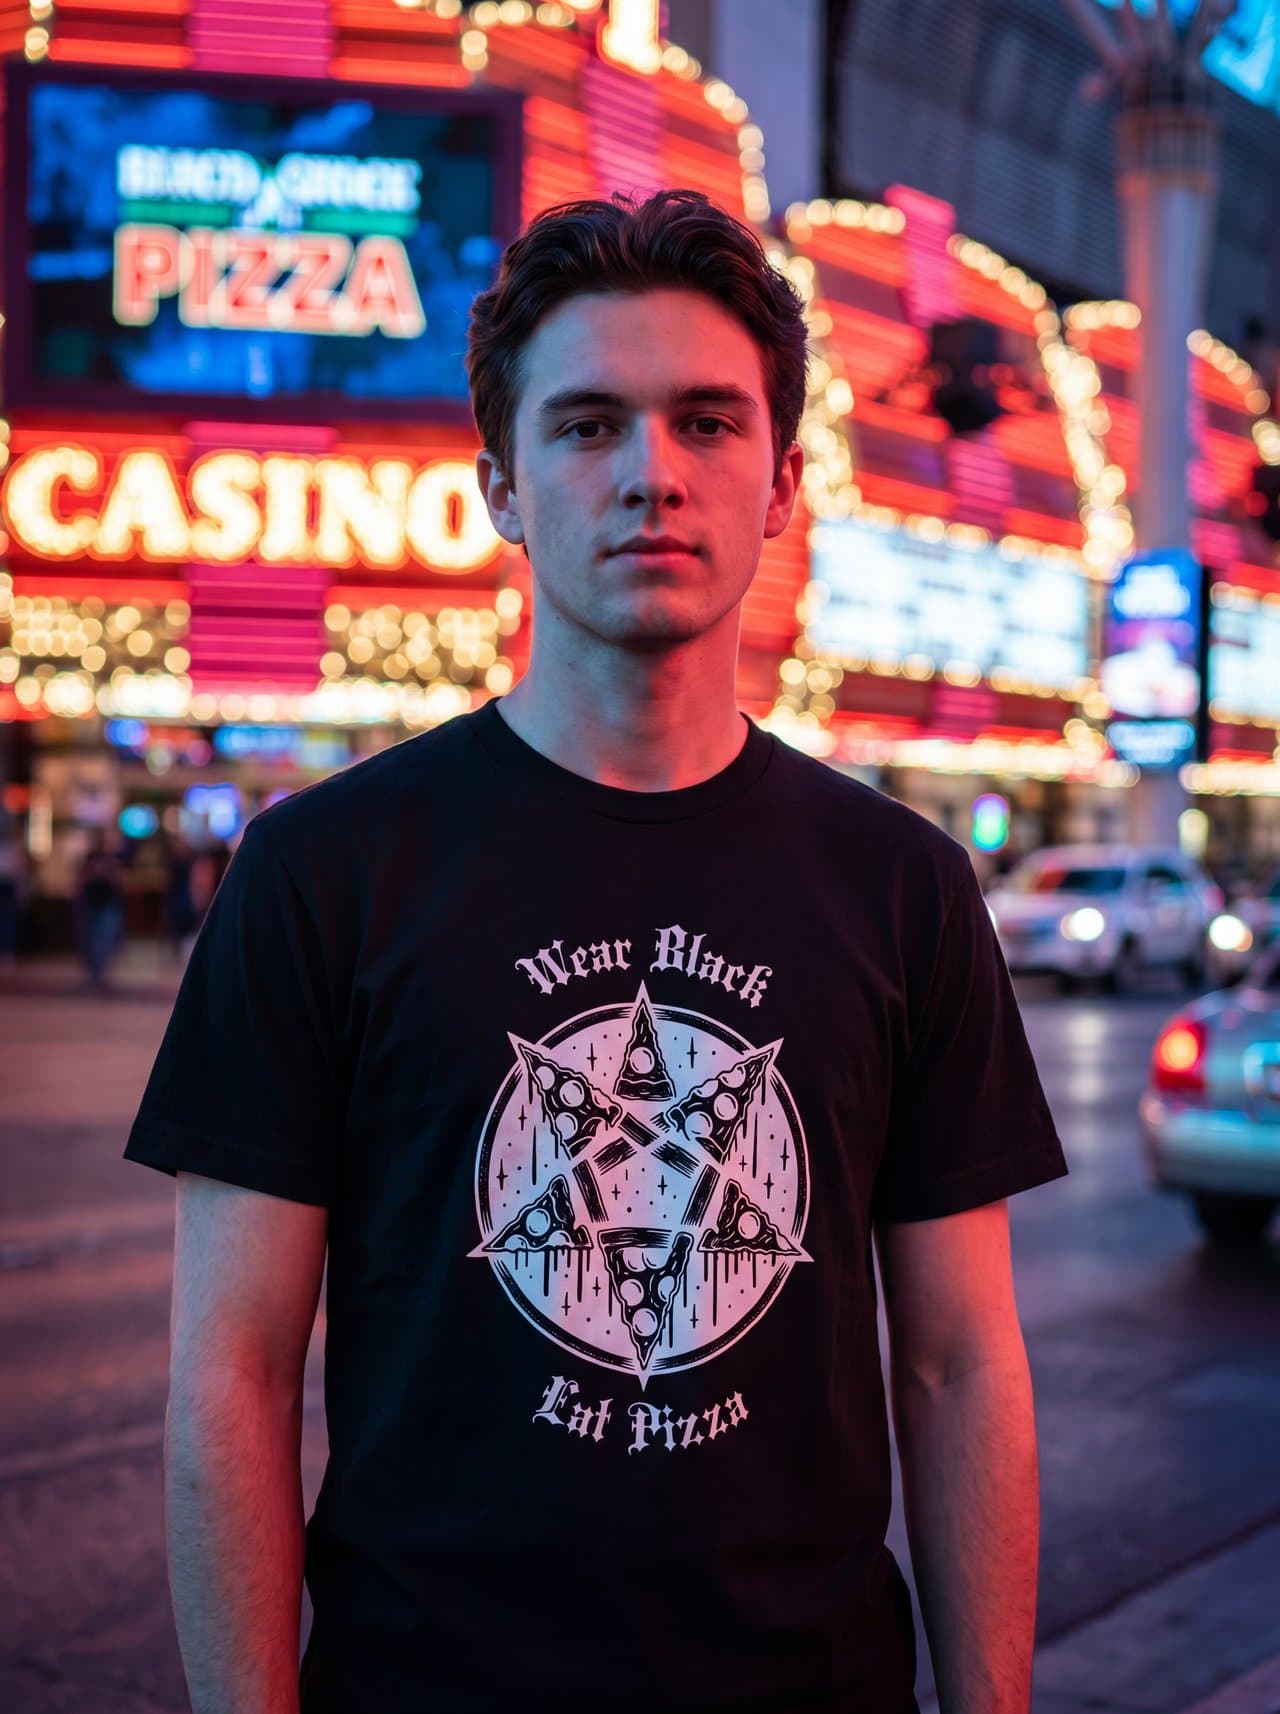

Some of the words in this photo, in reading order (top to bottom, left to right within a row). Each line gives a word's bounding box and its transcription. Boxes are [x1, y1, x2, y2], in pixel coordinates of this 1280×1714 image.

[113, 224, 427, 339] PIZZA
[4, 444, 505, 574] CASINO
[515, 939, 632, 995] Wear
[650, 924, 773, 1008] Black
[532, 1376, 614, 1443] Eat
[627, 1391, 749, 1456] Pizza
